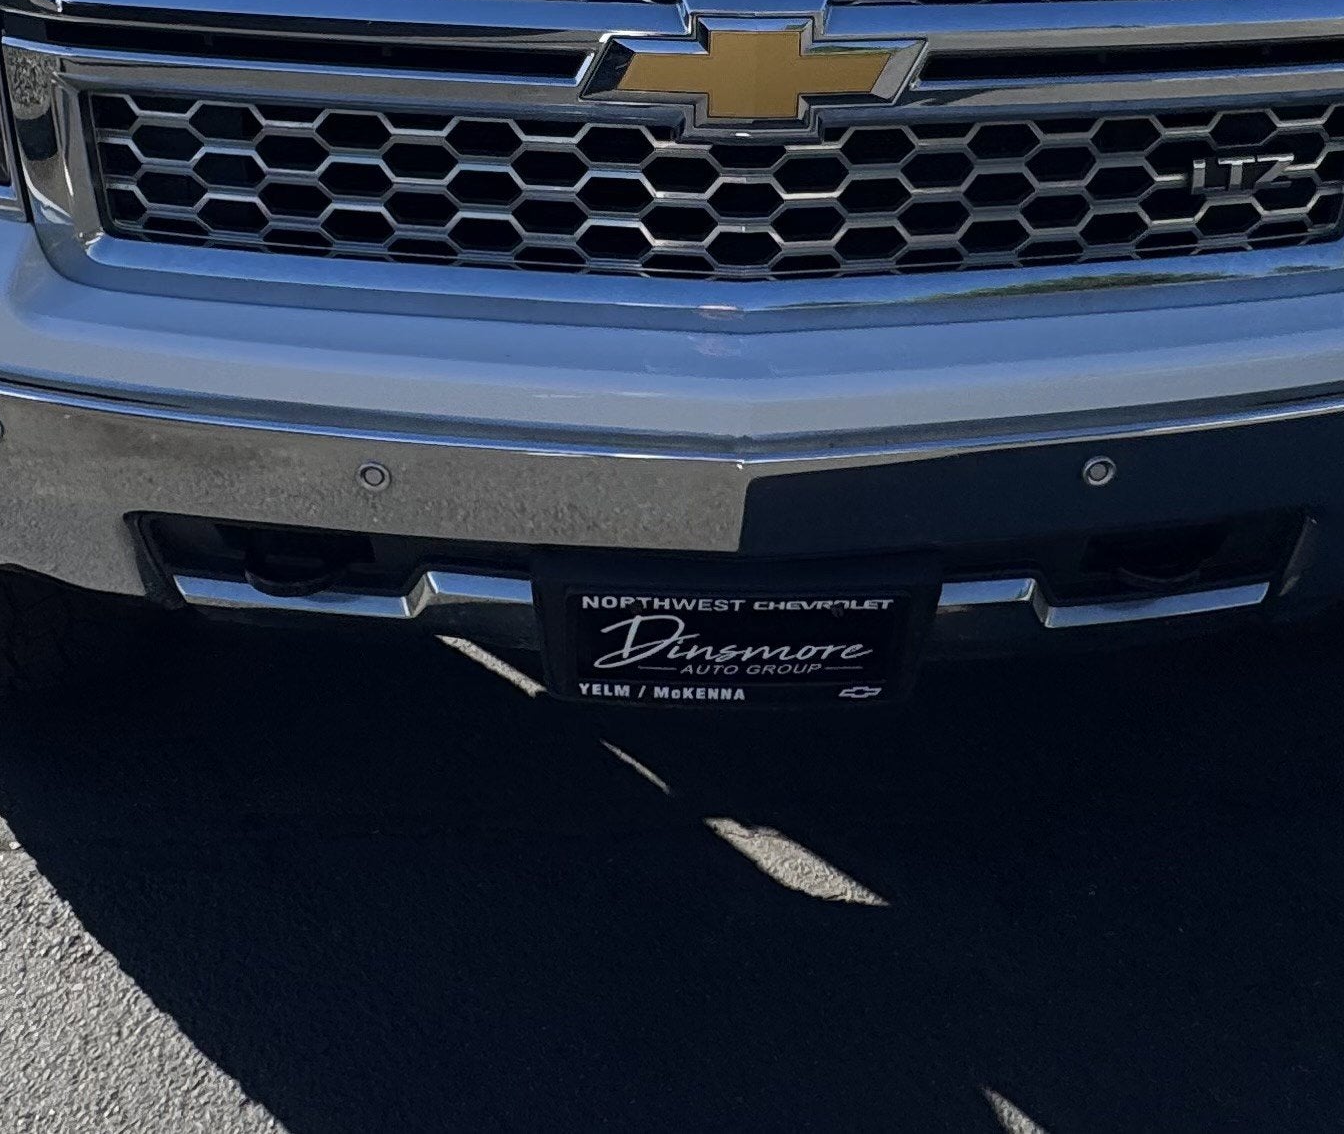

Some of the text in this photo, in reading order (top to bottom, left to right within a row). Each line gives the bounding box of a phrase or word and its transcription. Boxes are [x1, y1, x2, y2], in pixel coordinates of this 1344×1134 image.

[1191, 153, 1295, 195] LTZ
[582, 596, 894, 612] NORTHWEST CHEVROLET
[594, 615, 874, 669] Dinsmore
[680, 663, 822, 676] AUTO GROUP
[579, 683, 630, 698] YELM
